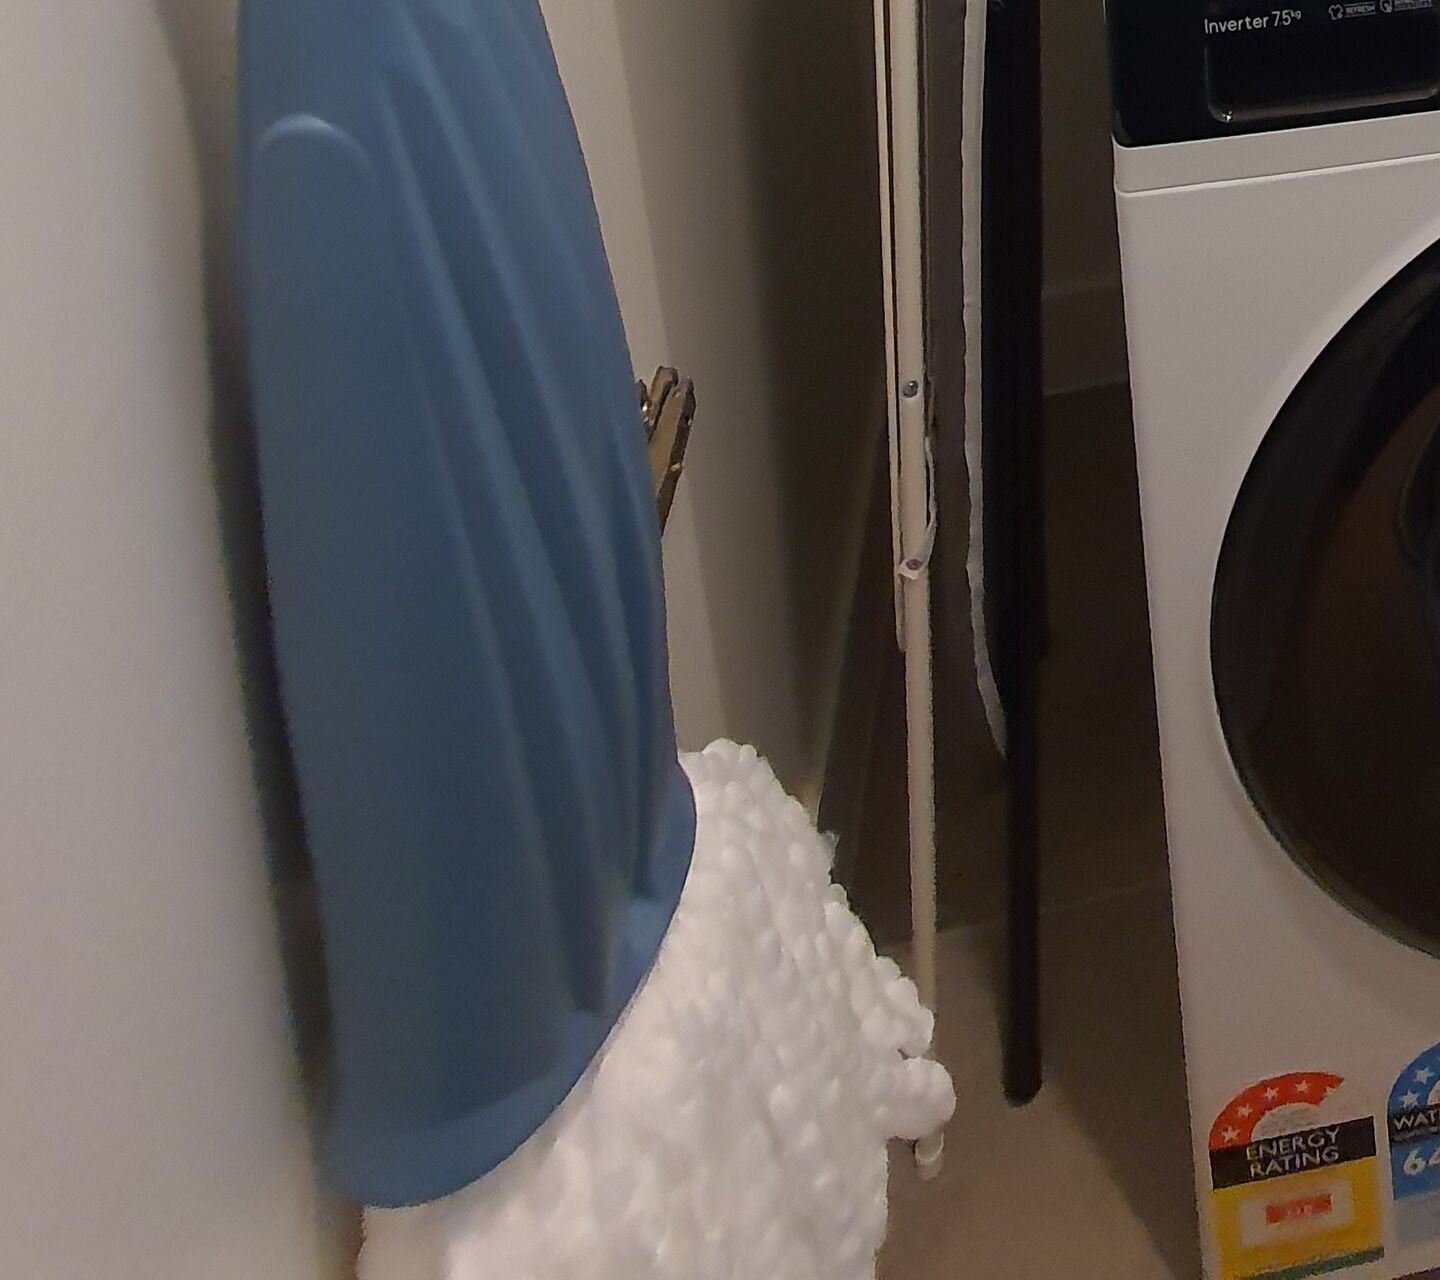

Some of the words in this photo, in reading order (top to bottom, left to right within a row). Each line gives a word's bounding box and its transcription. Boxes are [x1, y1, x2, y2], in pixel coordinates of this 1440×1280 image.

[1204, 14, 1270, 35] Inverter
[1246, 1125, 1341, 1161] ENERGY
[1249, 1145, 1340, 1178] RATING
